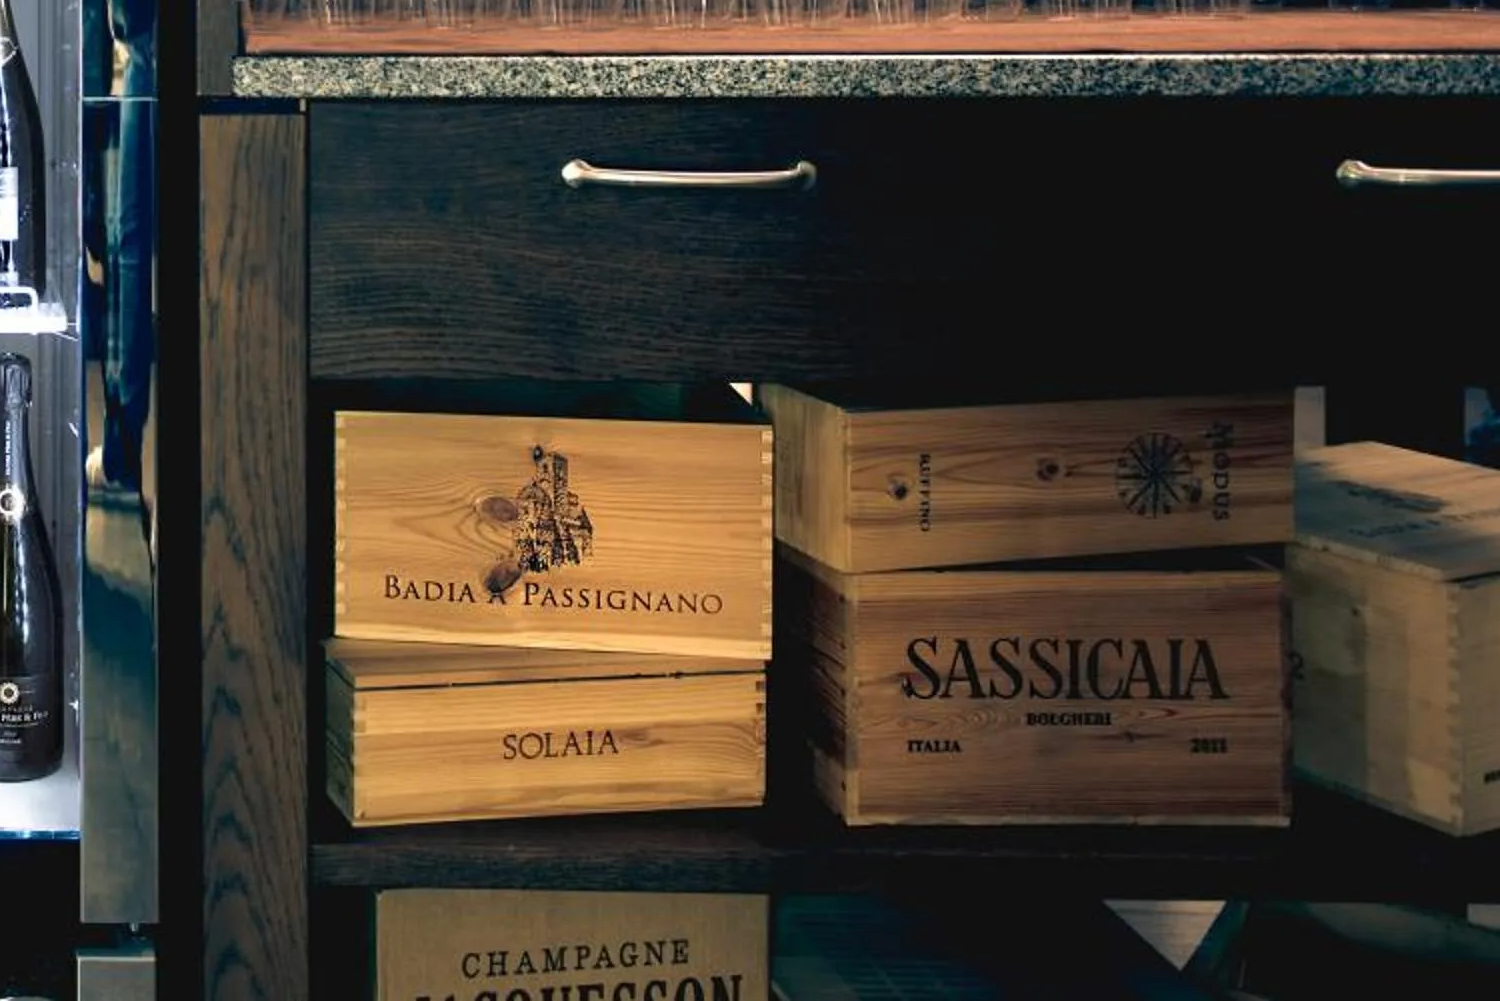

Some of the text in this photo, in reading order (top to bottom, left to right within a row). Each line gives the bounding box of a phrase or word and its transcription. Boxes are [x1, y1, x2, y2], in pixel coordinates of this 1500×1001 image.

[384, 574, 475, 604] BADIA
[524, 582, 723, 615] PASSIGNANO
[905, 636, 1230, 700] SASSICAIA
[1026, 712, 1113, 727] BOLGHERI
[503, 729, 619, 760] SOLAIA
[907, 739, 962, 753] ITALIA
[461, 938, 690, 979] CHAMPAGNE
